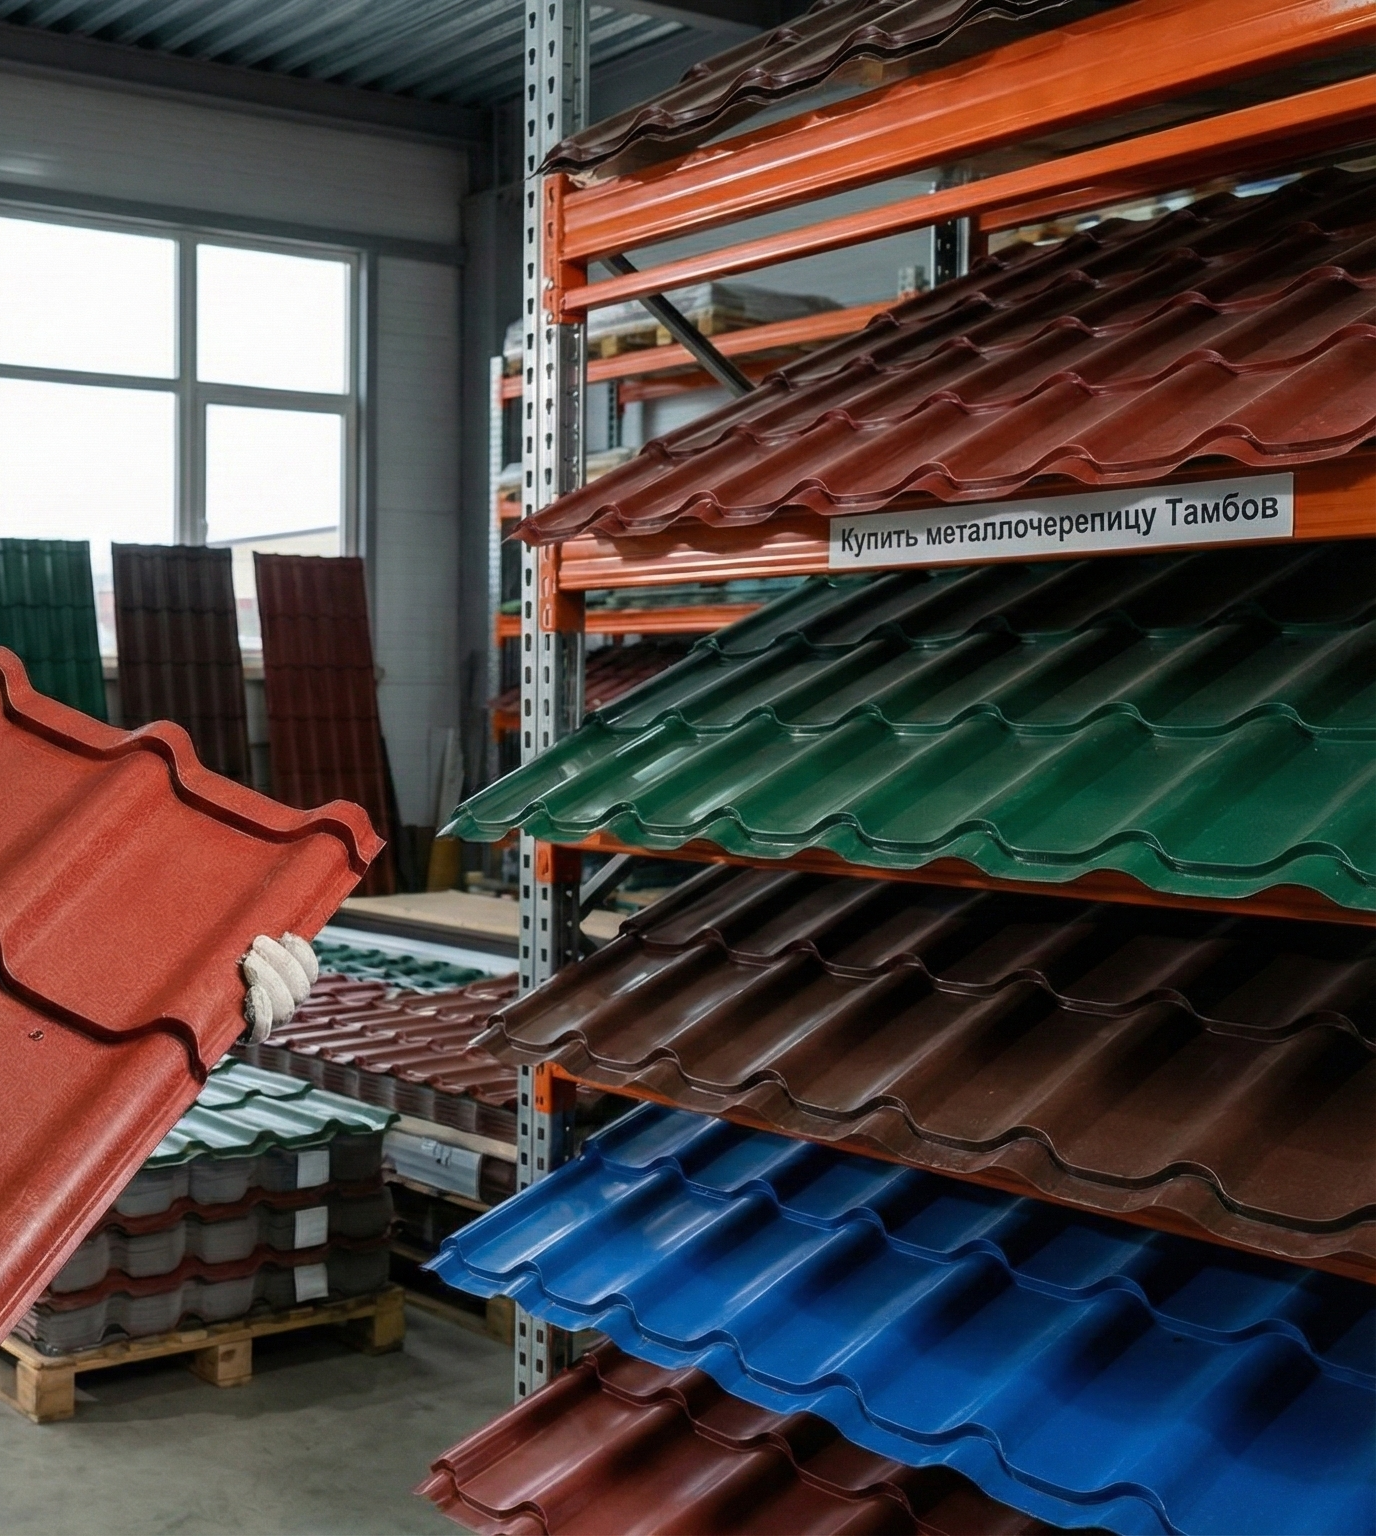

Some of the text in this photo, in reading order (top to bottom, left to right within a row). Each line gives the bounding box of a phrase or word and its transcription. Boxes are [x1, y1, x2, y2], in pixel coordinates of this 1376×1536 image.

[841, 492, 1279, 558] Купить металлочерепицу Тамбов
